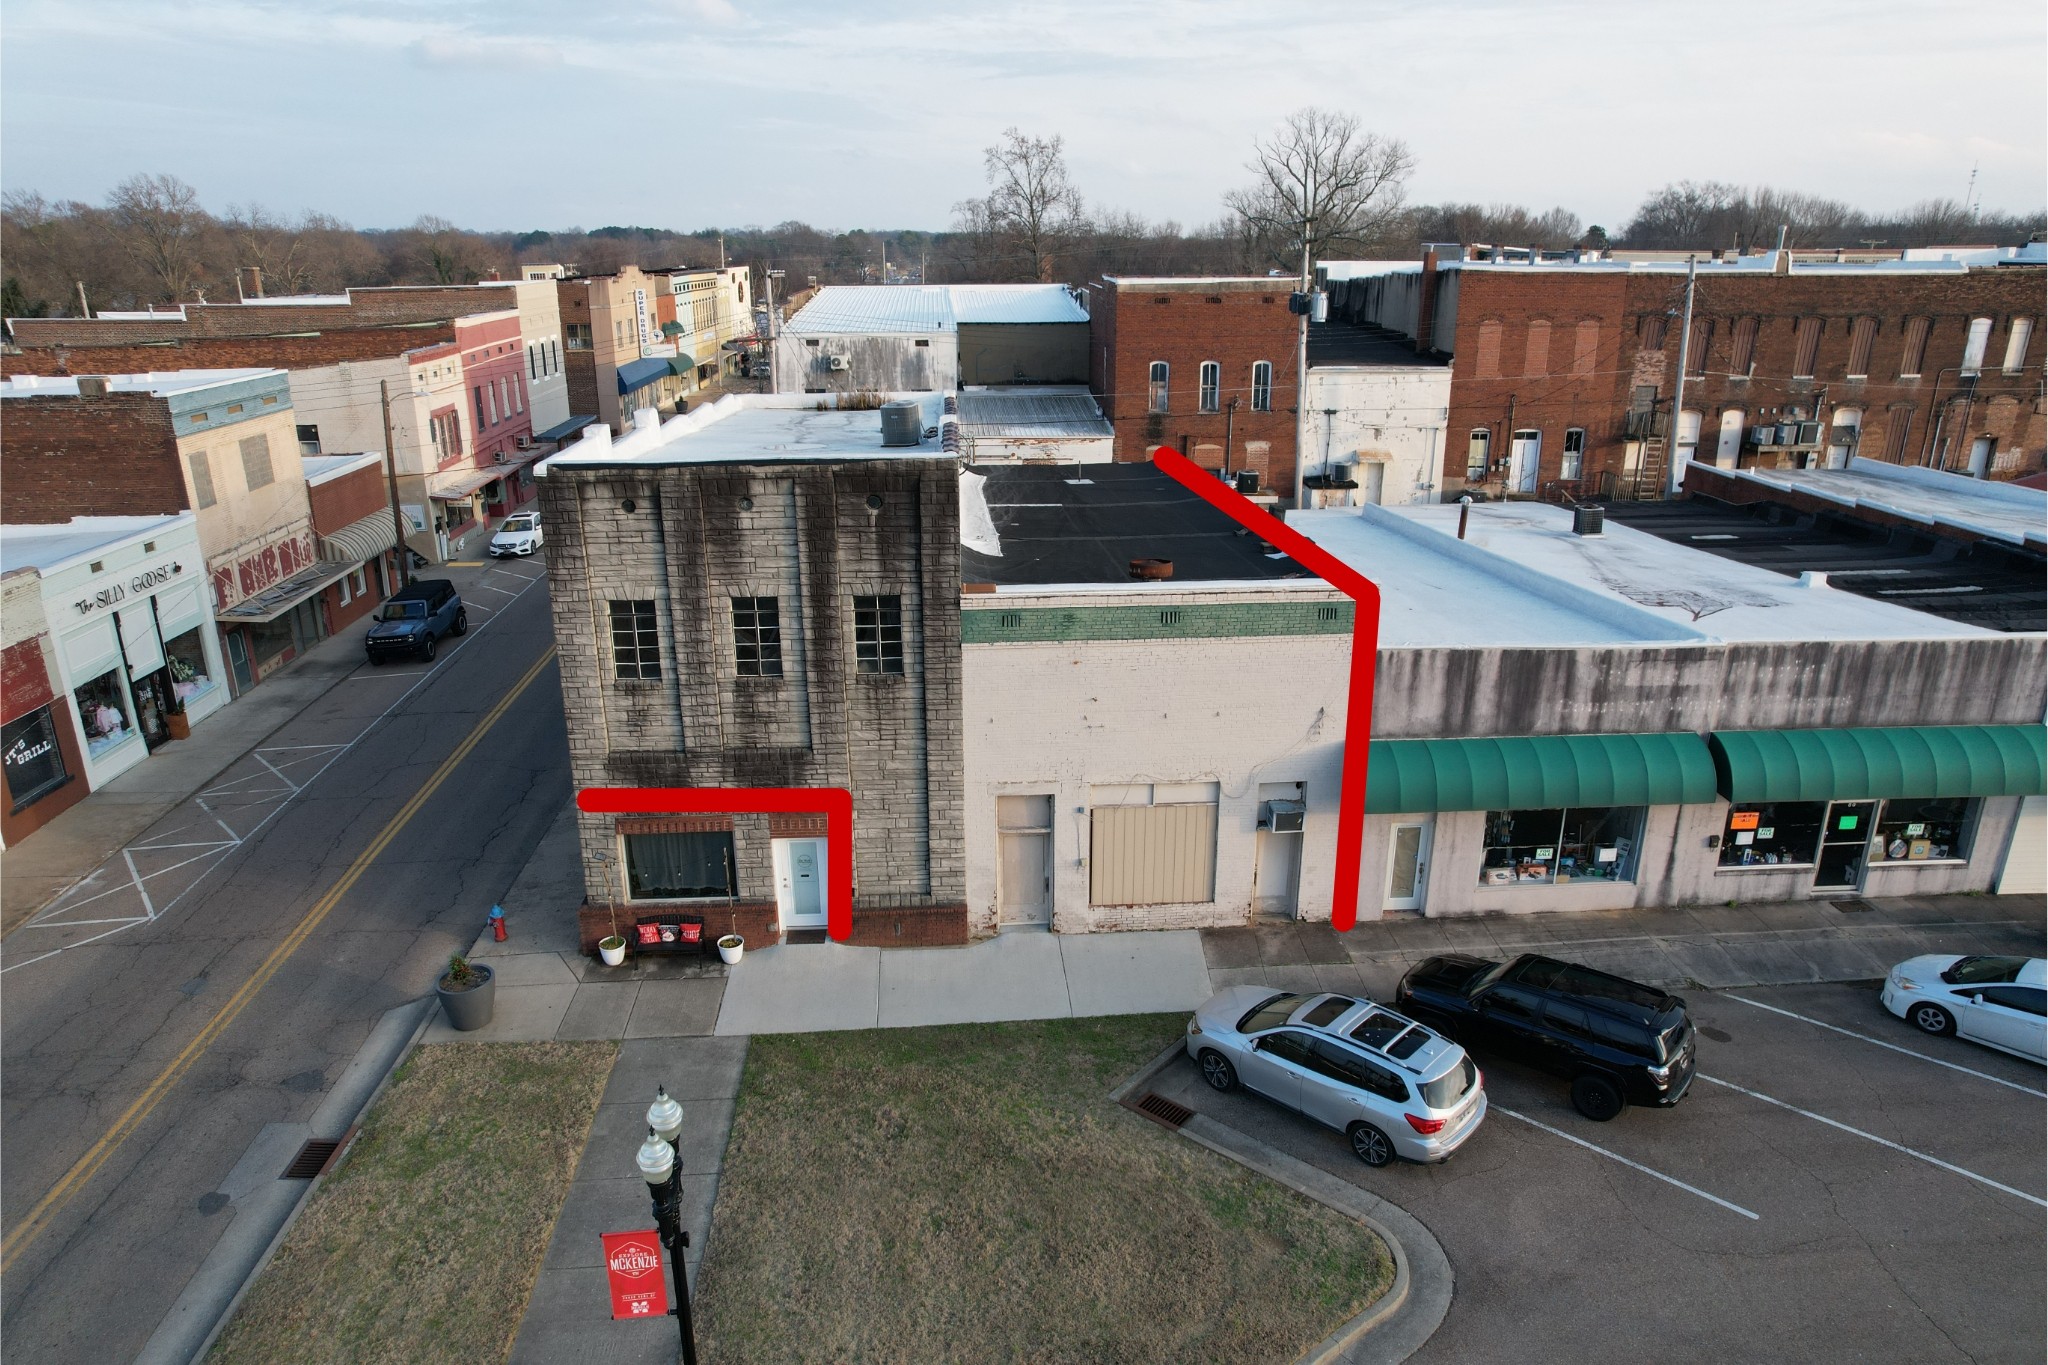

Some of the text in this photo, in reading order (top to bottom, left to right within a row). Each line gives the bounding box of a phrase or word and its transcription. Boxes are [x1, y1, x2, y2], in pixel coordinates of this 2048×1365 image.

[75, 564, 171, 614] The SILLY GOOSE
[5, 739, 26, 765] JT'S
[17, 741, 51, 764] GRILL
[610, 1255, 659, 1271] MCKENZIE
